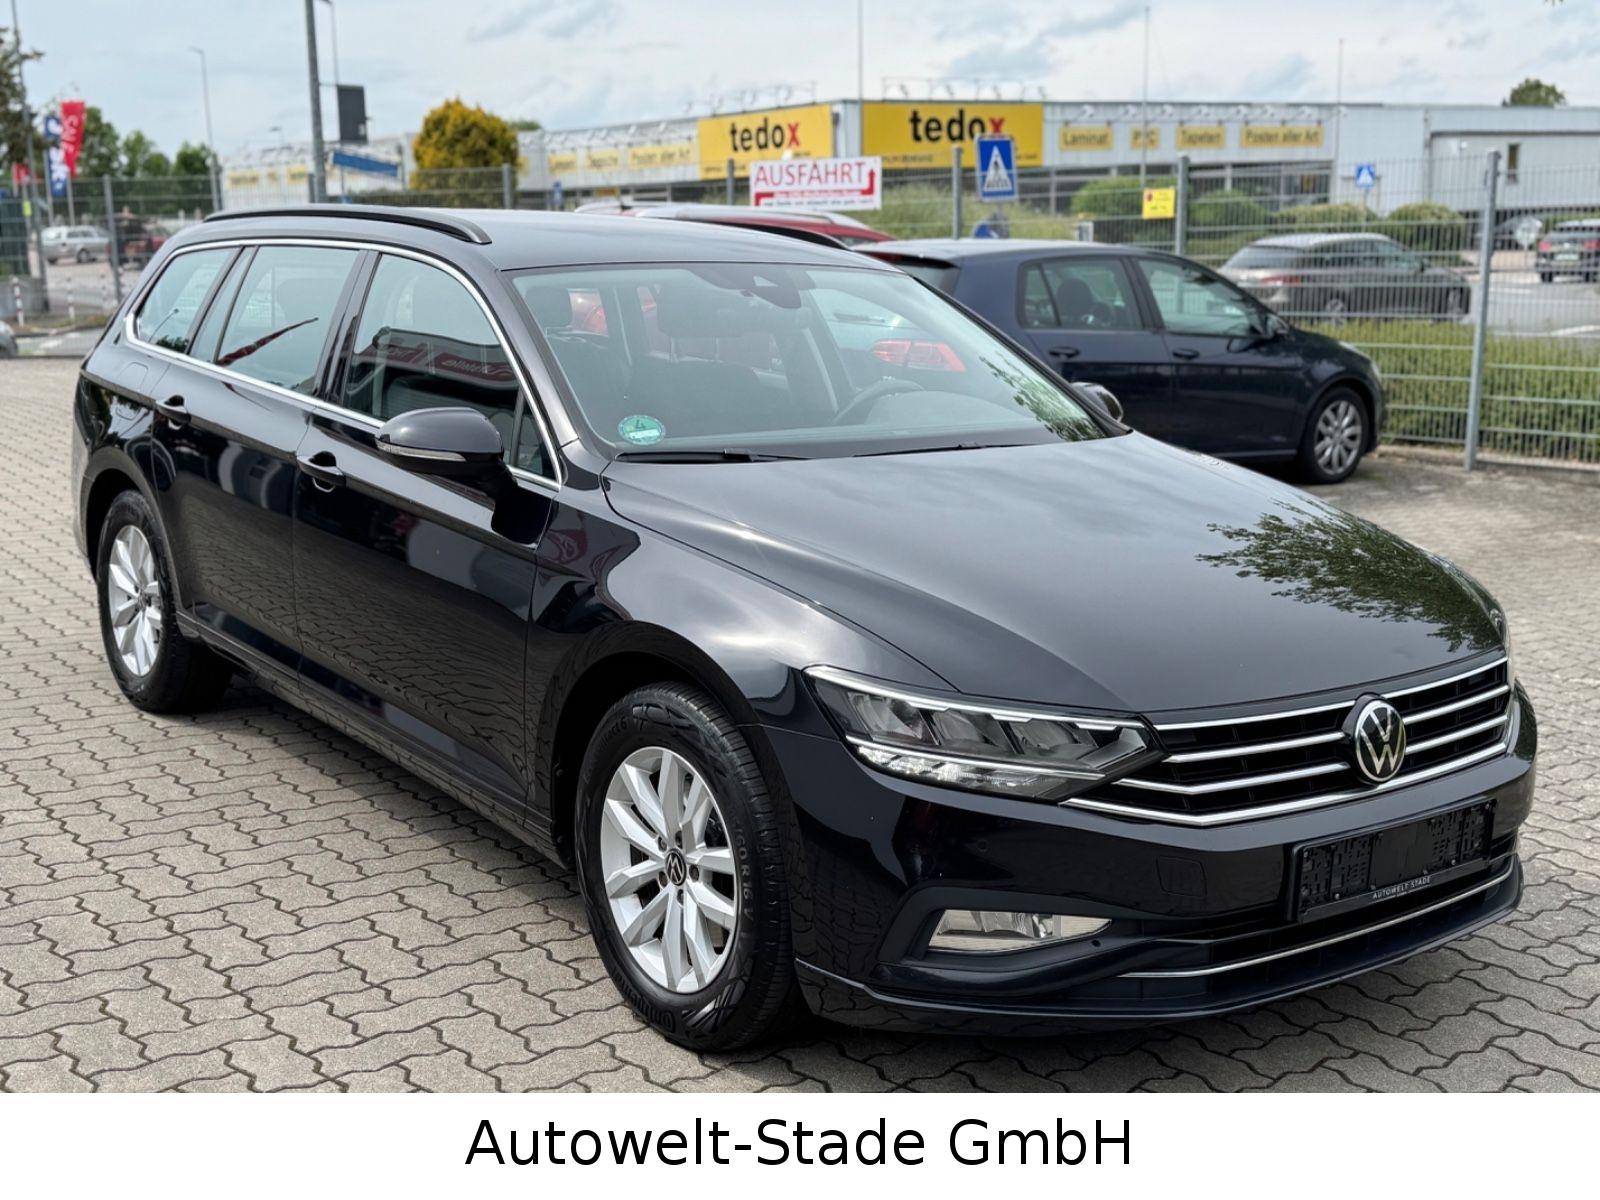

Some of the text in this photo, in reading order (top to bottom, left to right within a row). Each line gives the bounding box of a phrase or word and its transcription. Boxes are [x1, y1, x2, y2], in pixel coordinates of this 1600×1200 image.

[730, 117, 800, 151] tedox
[909, 108, 1005, 142] tedox
[1132, 129, 1156, 146] PC
[754, 161, 867, 187] AUSFAHRT
